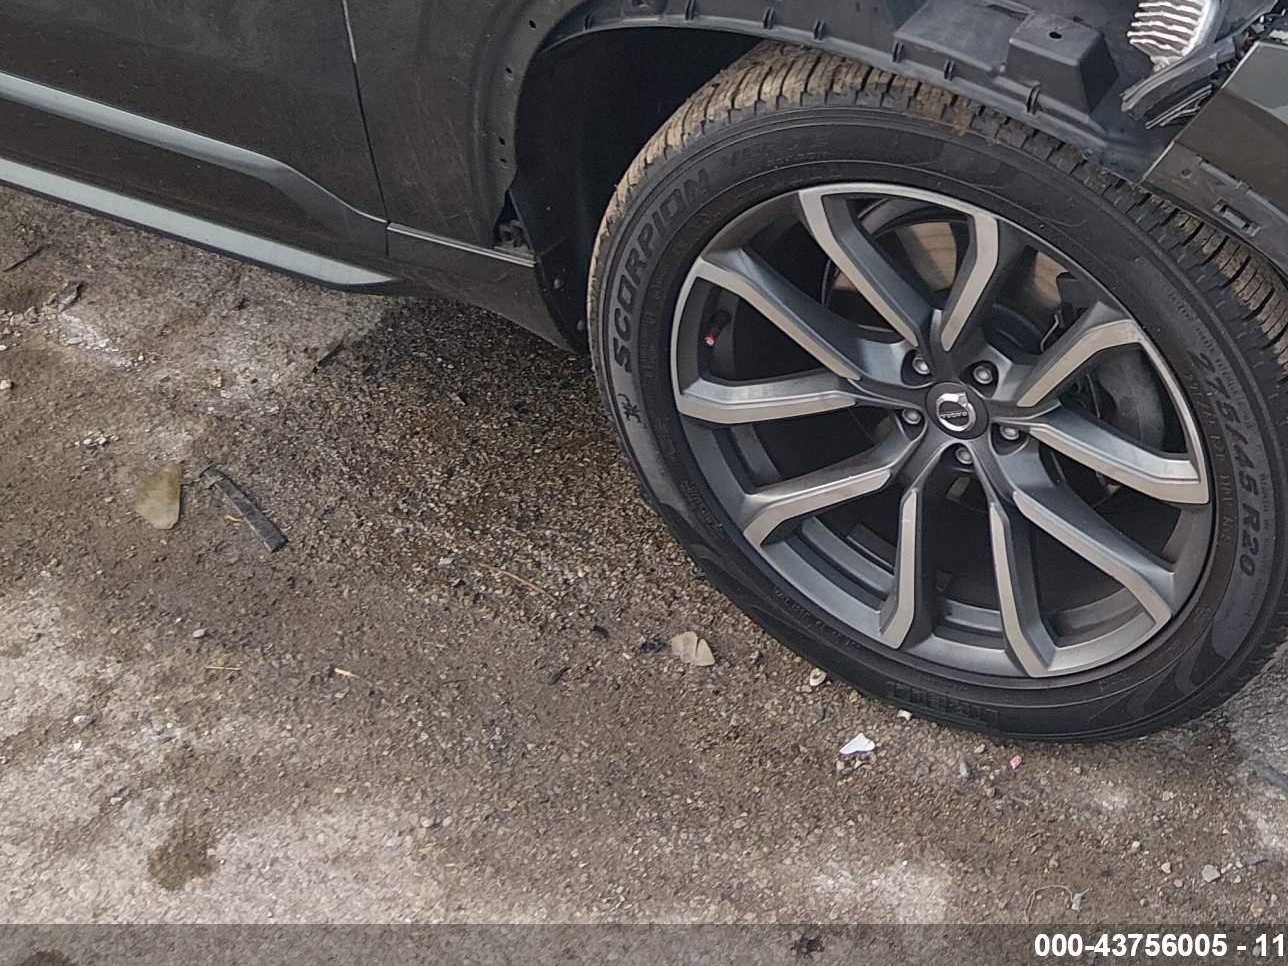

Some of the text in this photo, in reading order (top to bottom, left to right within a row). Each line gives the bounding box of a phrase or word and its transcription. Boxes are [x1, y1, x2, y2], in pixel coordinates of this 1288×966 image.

[613, 168, 715, 374] SCORPION
[1187, 350, 1259, 498] 275/45
[1239, 501, 1262, 577] R20
